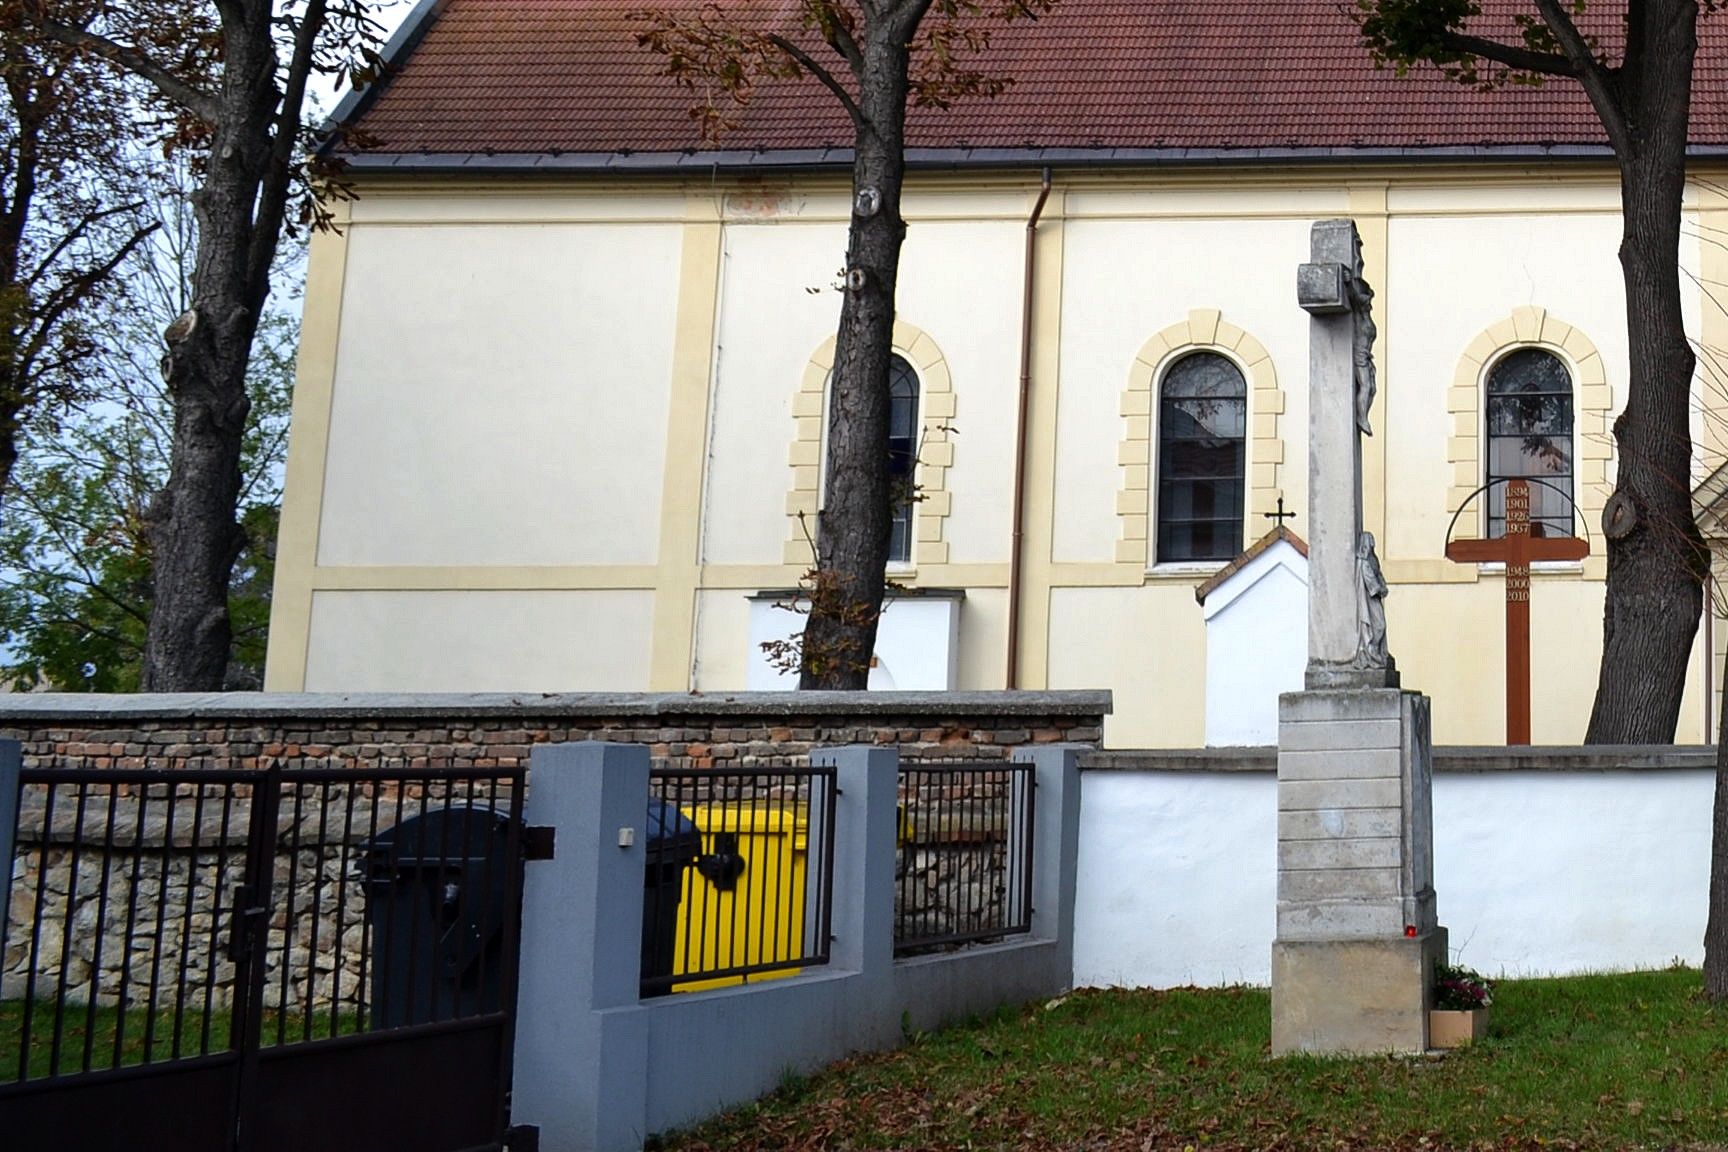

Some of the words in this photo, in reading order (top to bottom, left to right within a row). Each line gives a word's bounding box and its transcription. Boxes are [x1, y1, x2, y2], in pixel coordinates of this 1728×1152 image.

[1506, 498, 1529, 509] 1901
[1506, 510, 1530, 522] 1926
[1506, 565, 1529, 576] 1948
[1506, 578, 1529, 589] 2000
[1506, 590, 1529, 602] 2010
